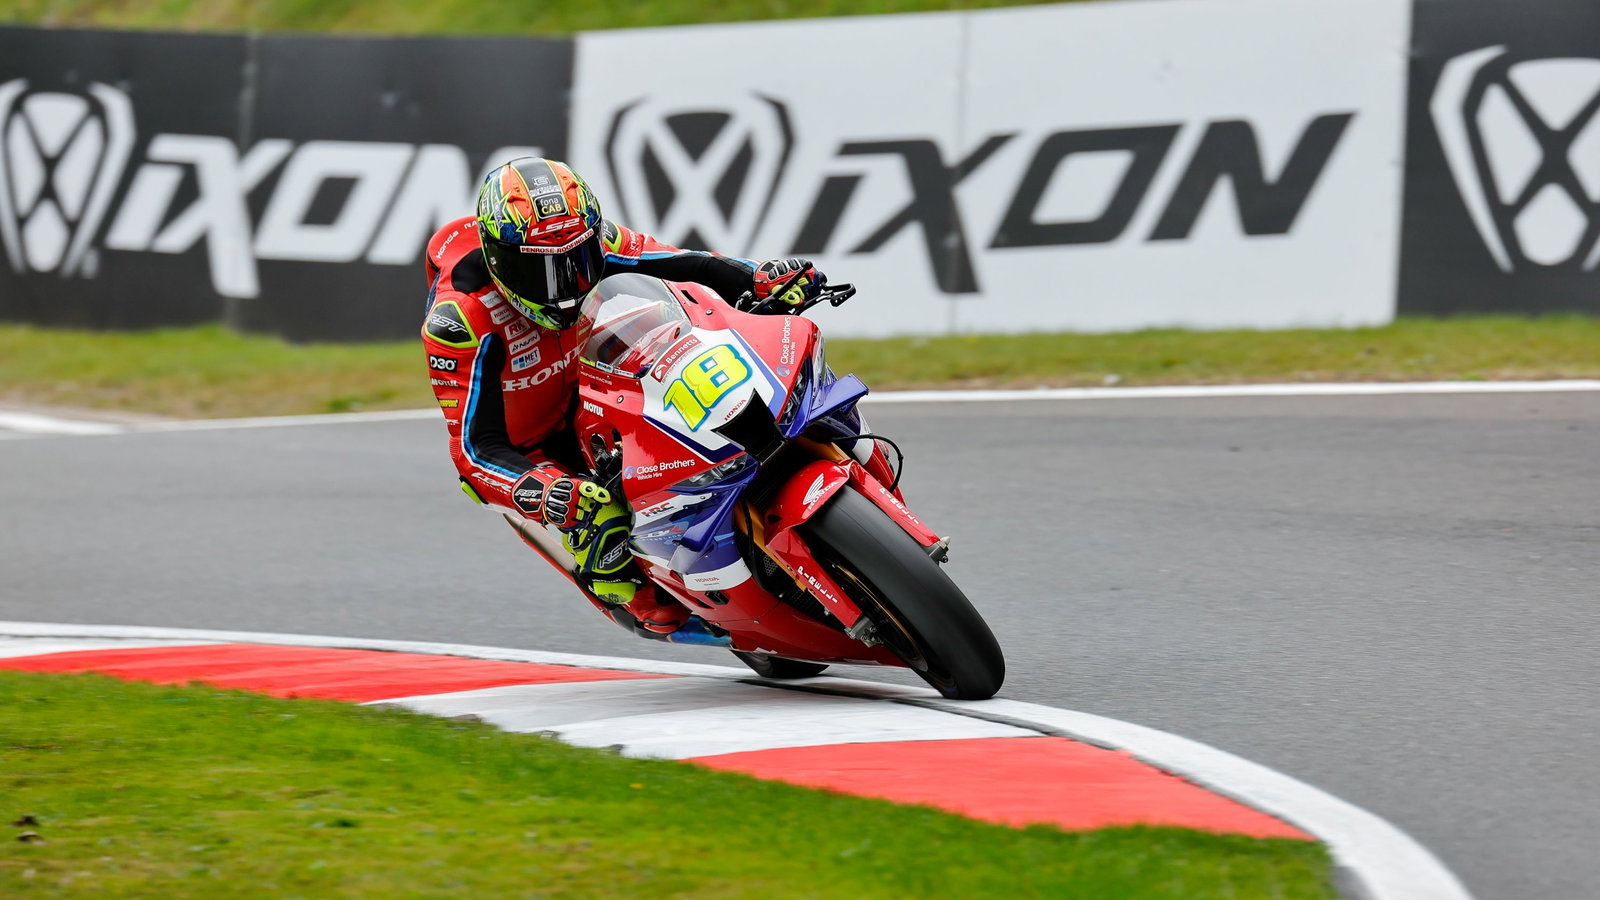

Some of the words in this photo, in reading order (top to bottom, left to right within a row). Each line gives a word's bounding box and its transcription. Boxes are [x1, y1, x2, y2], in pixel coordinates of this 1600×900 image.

[541, 203, 562, 214] CAB
[530, 217, 580, 237] LS2
[556, 237, 585, 254] ROOFING
[429, 313, 468, 334] RST
[782, 316, 792, 343] Brothers
[665, 338, 698, 364] Bennetts
[780, 344, 790, 364] Close
[663, 343, 753, 432] 18
[583, 400, 604, 417] MOTUL
[723, 399, 748, 421] HONDA
[636, 464, 658, 475] Close
[659, 458, 696, 471] Brothers
[878, 487, 920, 525] PIRELLI
[797, 565, 839, 603] PIRELLI
